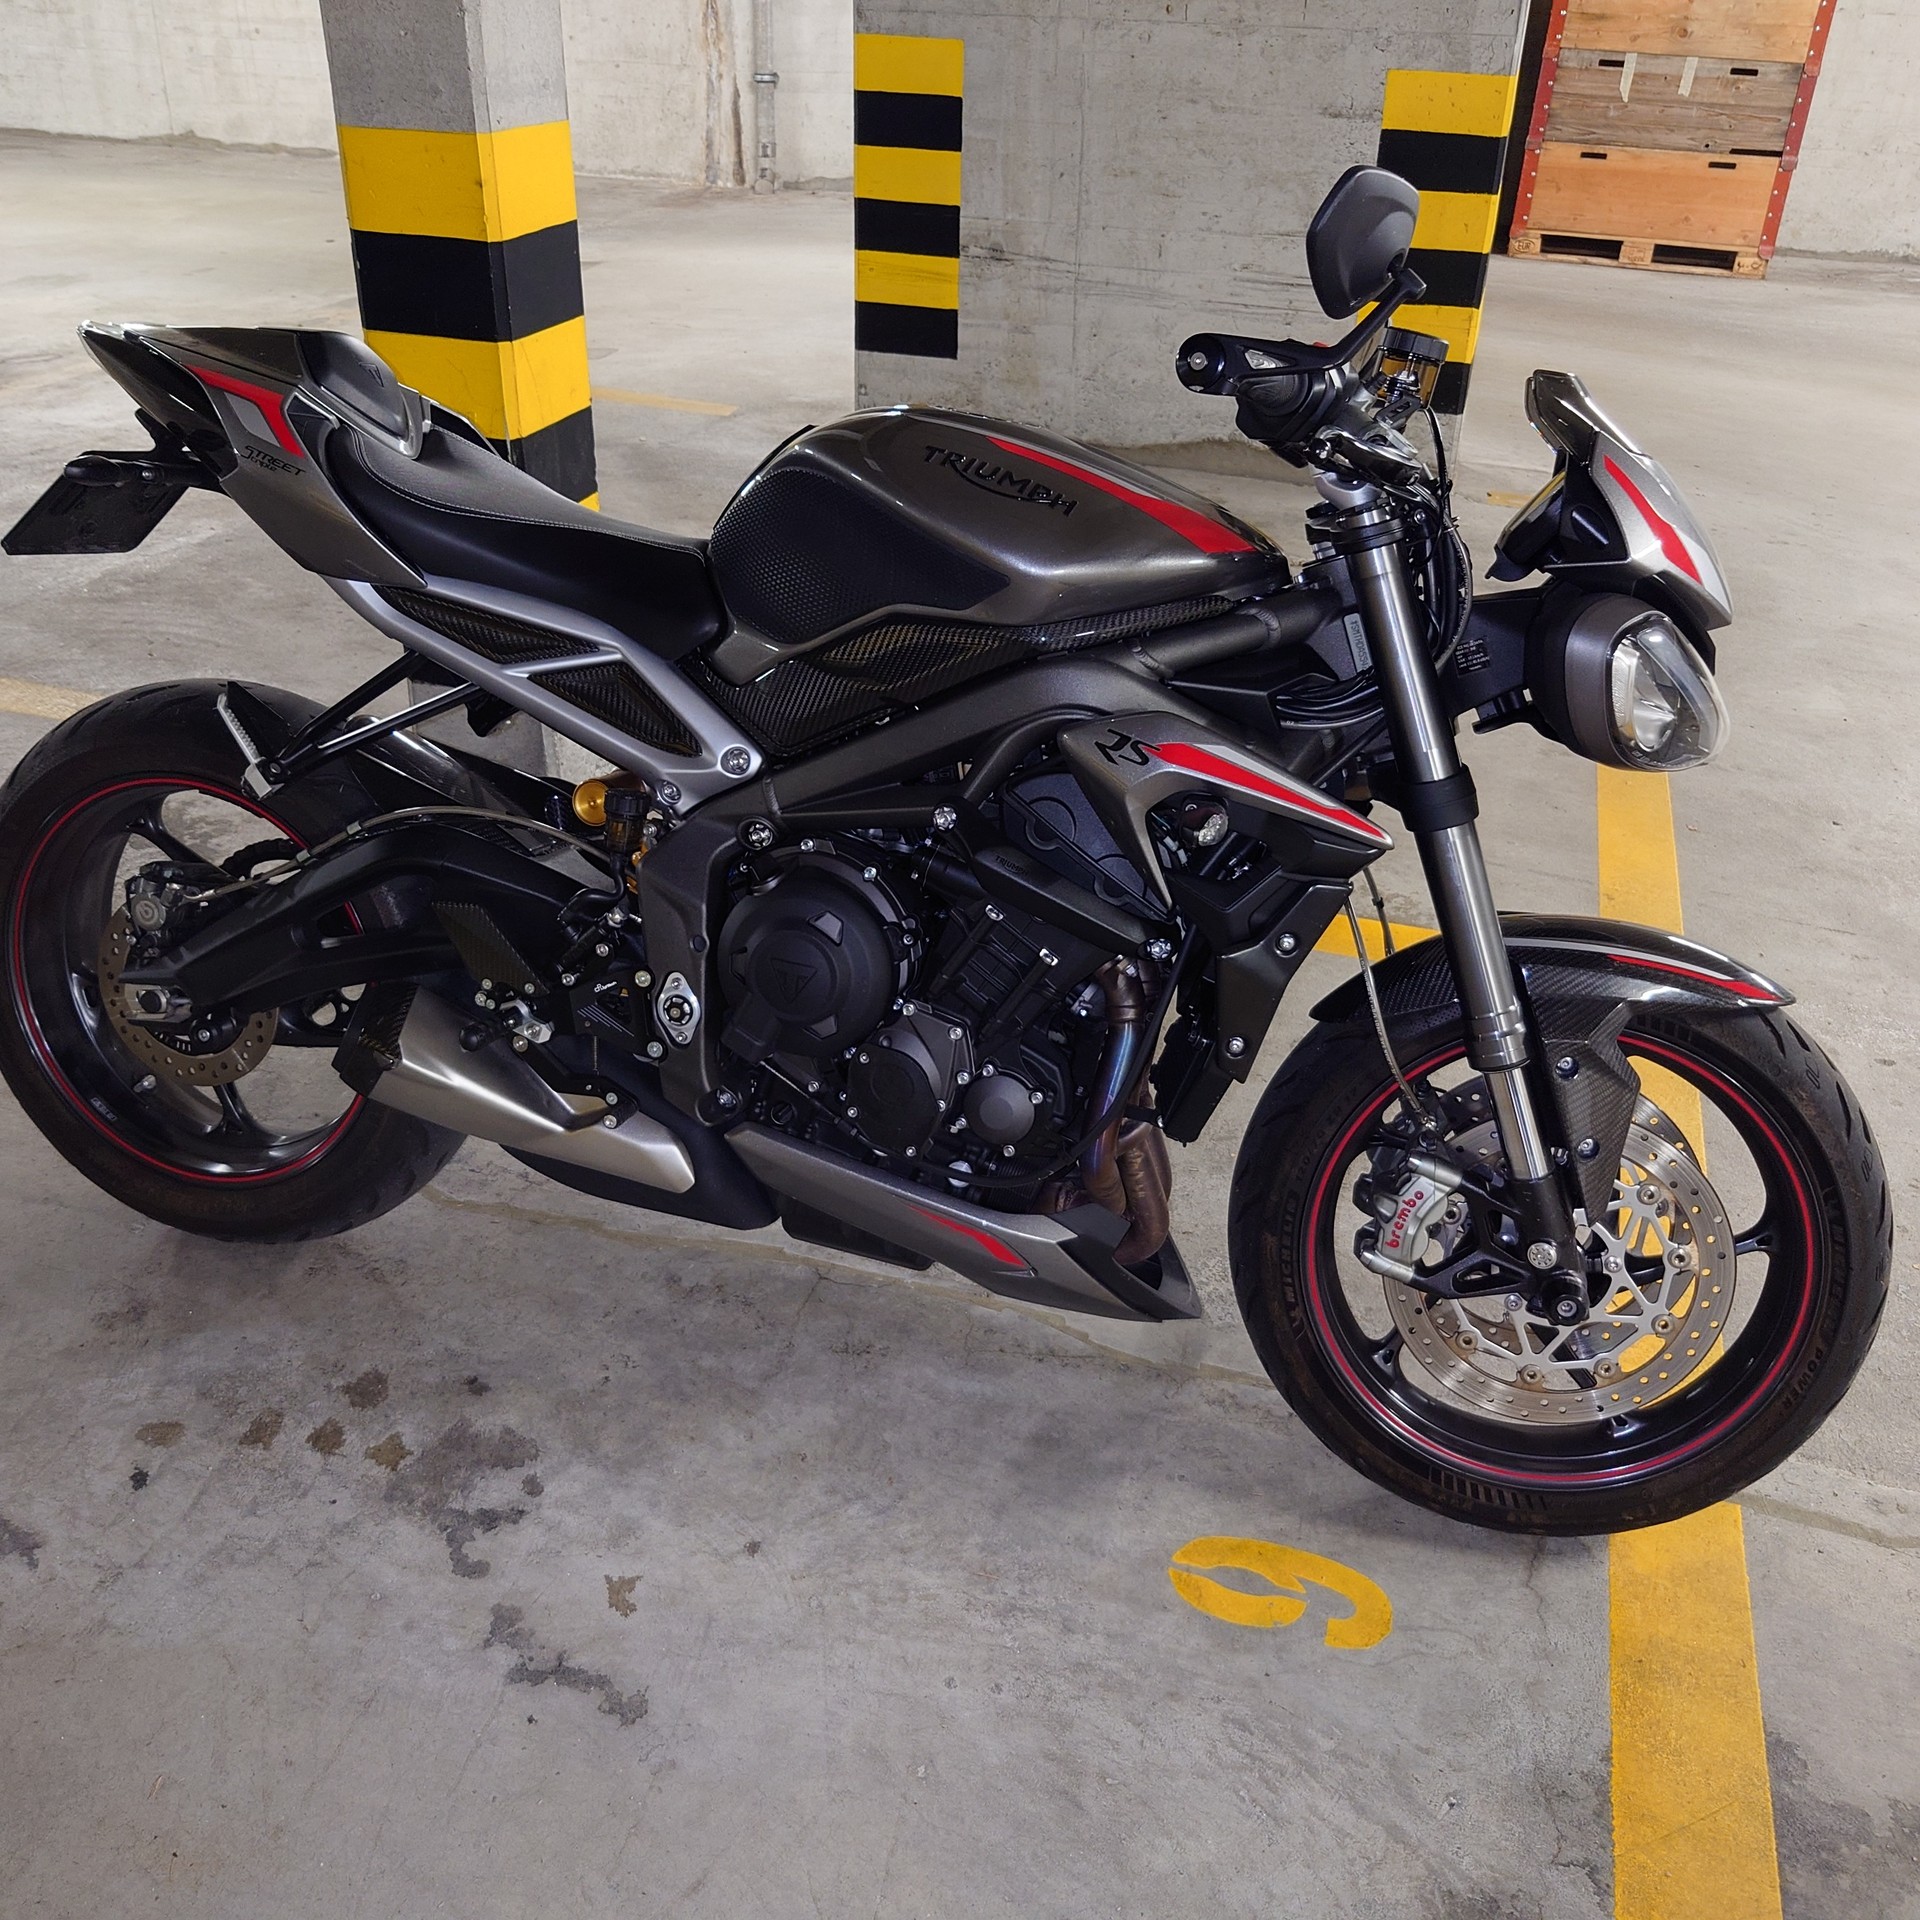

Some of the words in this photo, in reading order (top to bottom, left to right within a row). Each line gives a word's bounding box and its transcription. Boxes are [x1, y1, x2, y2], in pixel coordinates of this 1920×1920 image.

[241, 445, 306, 476] STREET
[924, 445, 1079, 517] TRIUMPH
[1094, 728, 1161, 766] RS
[995, 855, 1028, 876] TRIUMPH
[1385, 1190, 1424, 1248] brembo
[1783, 1346, 1824, 1409] POWER
